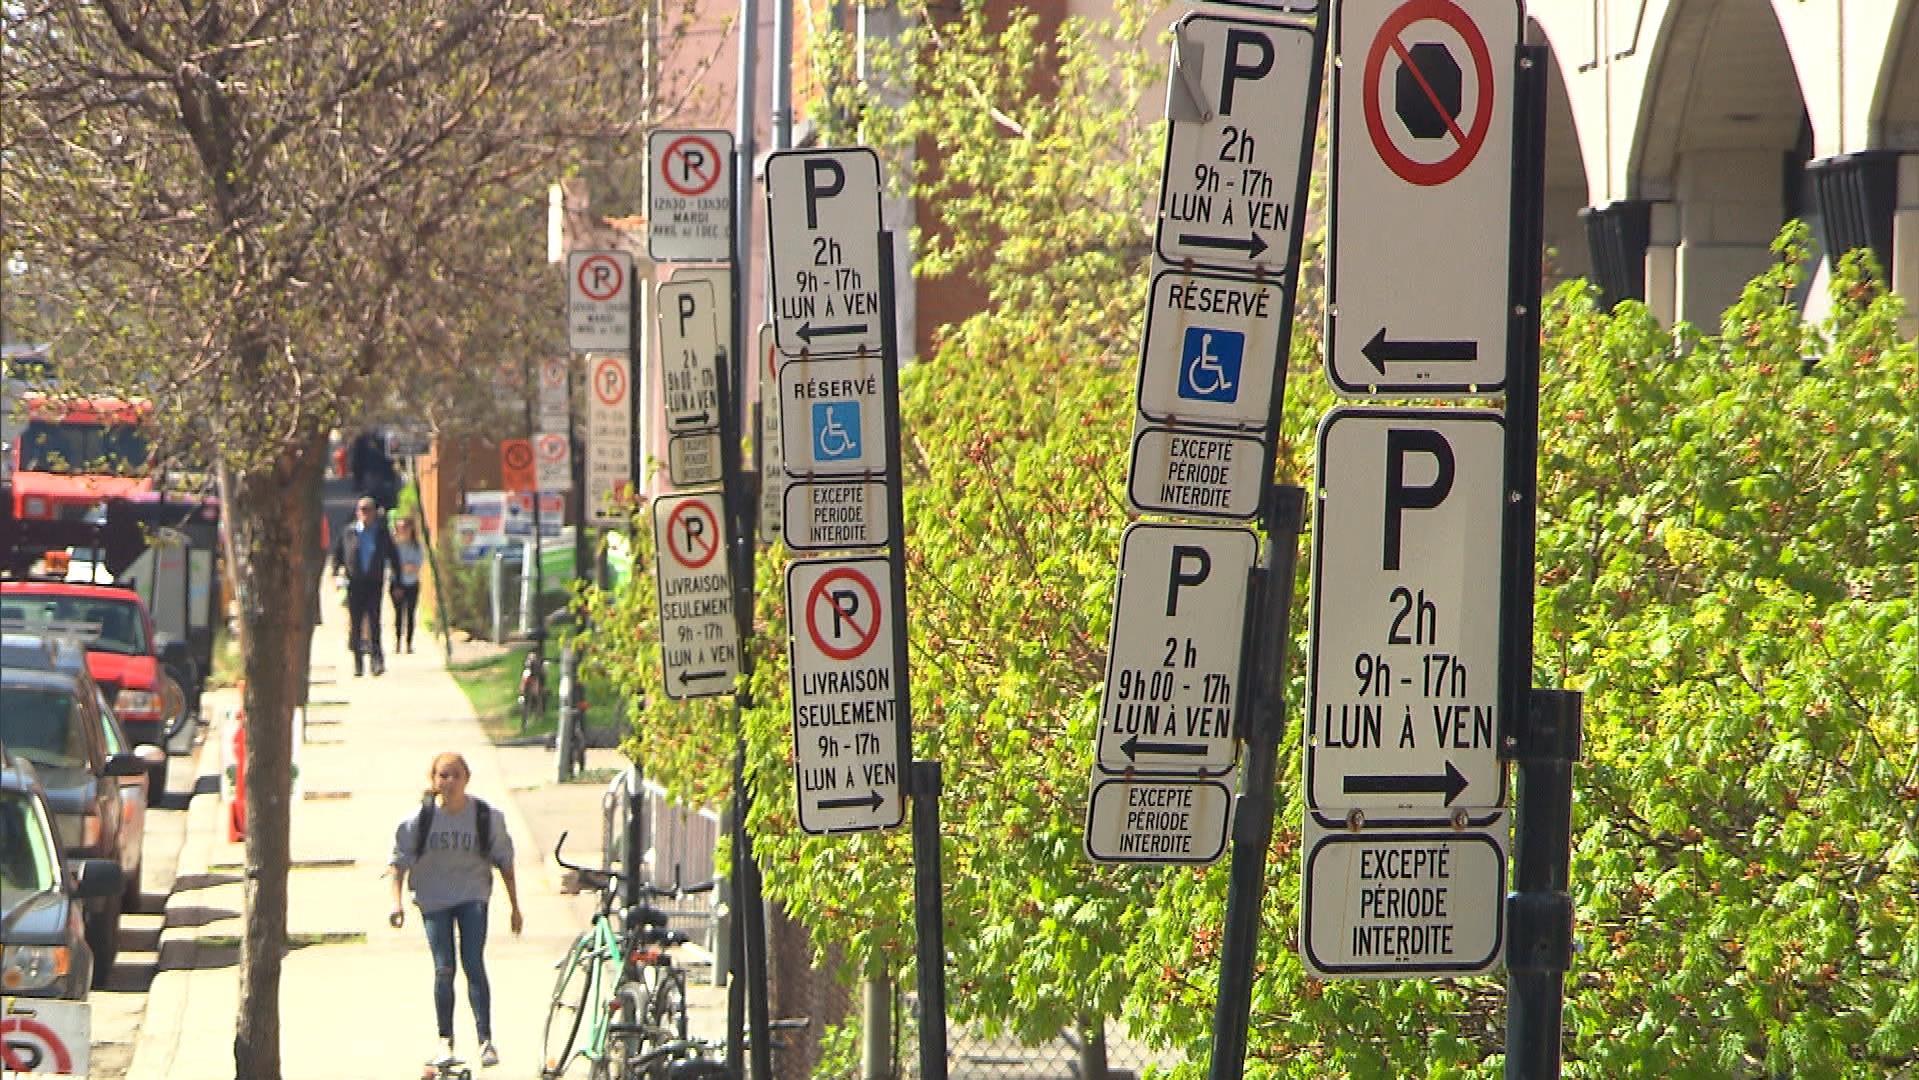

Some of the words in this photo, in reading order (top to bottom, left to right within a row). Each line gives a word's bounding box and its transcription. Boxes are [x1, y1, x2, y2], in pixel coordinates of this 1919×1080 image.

[1219, 28, 1275, 116] P
[1219, 126, 1255, 164] 2h
[805, 159, 845, 230] P
[1195, 164, 1219, 192] 9h
[1241, 168, 1273, 198] 17h
[1171, 192, 1212, 223] LUN
[1248, 200, 1289, 230] VEN
[813, 237, 841, 266] 2h
[797, 271, 818, 293] 9h
[836, 268, 861, 291] 17h
[782, 295, 815, 318] LUN
[844, 292, 878, 315] VEN
[1168, 280, 1269, 318] RÉSERVÉ
[678, 293, 696, 338] P
[794, 374, 876, 398] RÉSERVÉ
[1170, 438, 1233, 462] EXCEPTÉ
[1168, 459, 1230, 485] PÉRIODE
[1160, 483, 1232, 508] INTERDITE
[1383, 429, 1456, 570] P
[810, 525, 867, 542] INTERDITE
[666, 574, 729, 596] LIVRAISON
[1166, 545, 1211, 616] P
[663, 598, 734, 620] SEULEMENT
[832, 589, 859, 638] P
[1388, 586, 1436, 645] 2h
[678, 626, 693, 641] 9h
[704, 623, 723, 639] 17h
[668, 650, 692, 667] LUN
[711, 645, 735, 662] VEN
[803, 668, 889, 695] LIVRAISON
[1203, 673, 1230, 704] 17h
[1355, 652, 1390, 697] 9h
[1423, 653, 1466, 697] 17h
[799, 700, 896, 727] SEULEMENT
[1113, 703, 1160, 734] LUN
[1186, 707, 1231, 738] VEN
[1325, 704, 1382, 748] LUN
[1400, 705, 1415, 748] À
[1433, 705, 1492, 748] VEN
[818, 735, 838, 758] 9h
[855, 732, 880, 755] 17h
[805, 766, 836, 790] LUN
[863, 761, 896, 785] VEN
[1129, 786, 1193, 808] EXCEPTÉ
[1127, 808, 1190, 831] PÉRIODE
[1119, 833, 1192, 853] INTERDITE
[1361, 844, 1450, 880] EXCEPTÉ
[1361, 883, 1447, 919] PÉRIODE
[1352, 926, 1453, 957] INTERDITE
